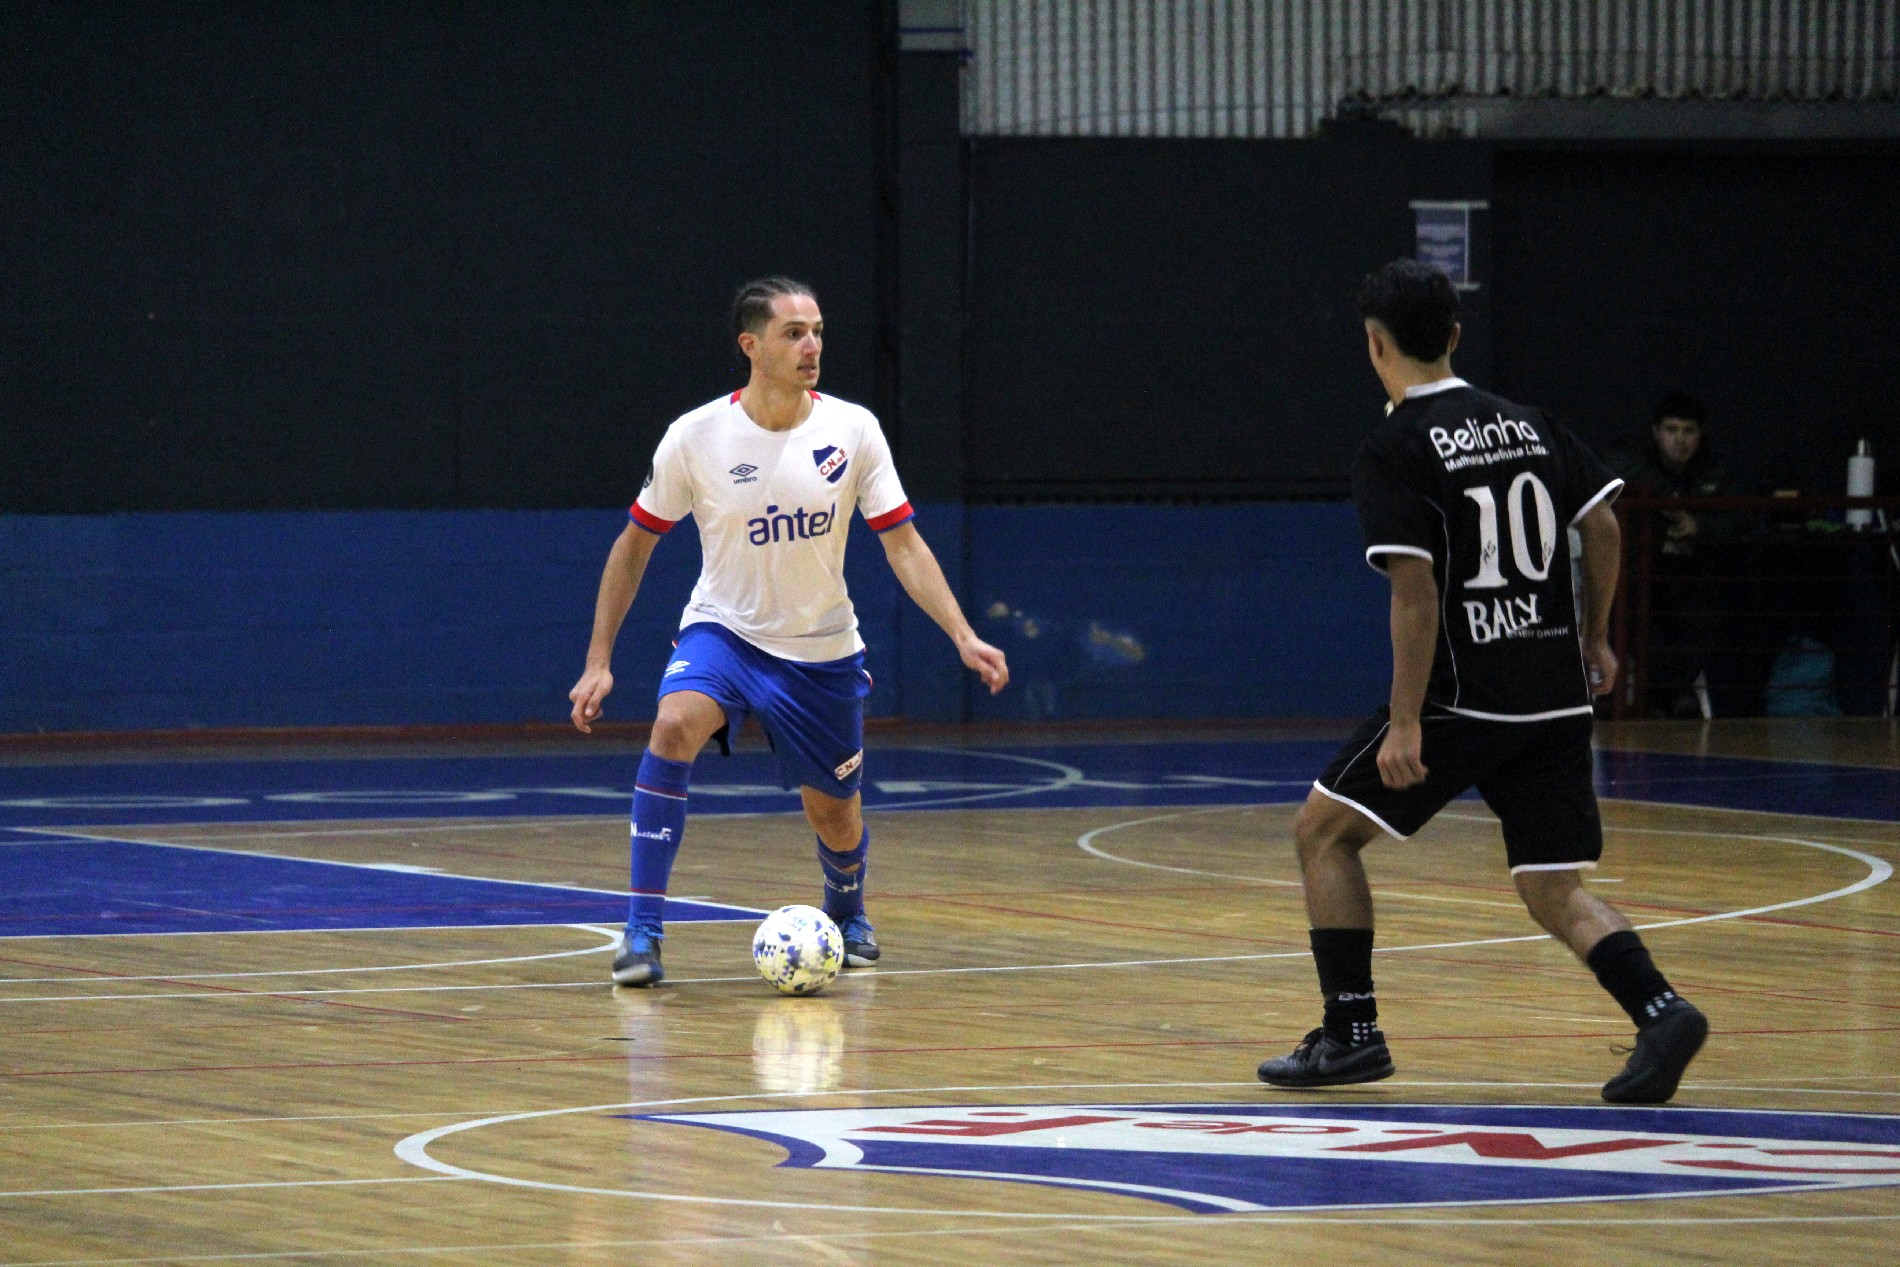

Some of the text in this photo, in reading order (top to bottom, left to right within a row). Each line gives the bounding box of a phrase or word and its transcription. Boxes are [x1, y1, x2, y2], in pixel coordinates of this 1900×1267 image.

[1429, 413, 1540, 459] Belinha
[733, 476, 758, 485] umbro
[747, 502, 836, 546] antel
[1463, 471, 1557, 589] 10
[1462, 593, 1539, 644] BALY
